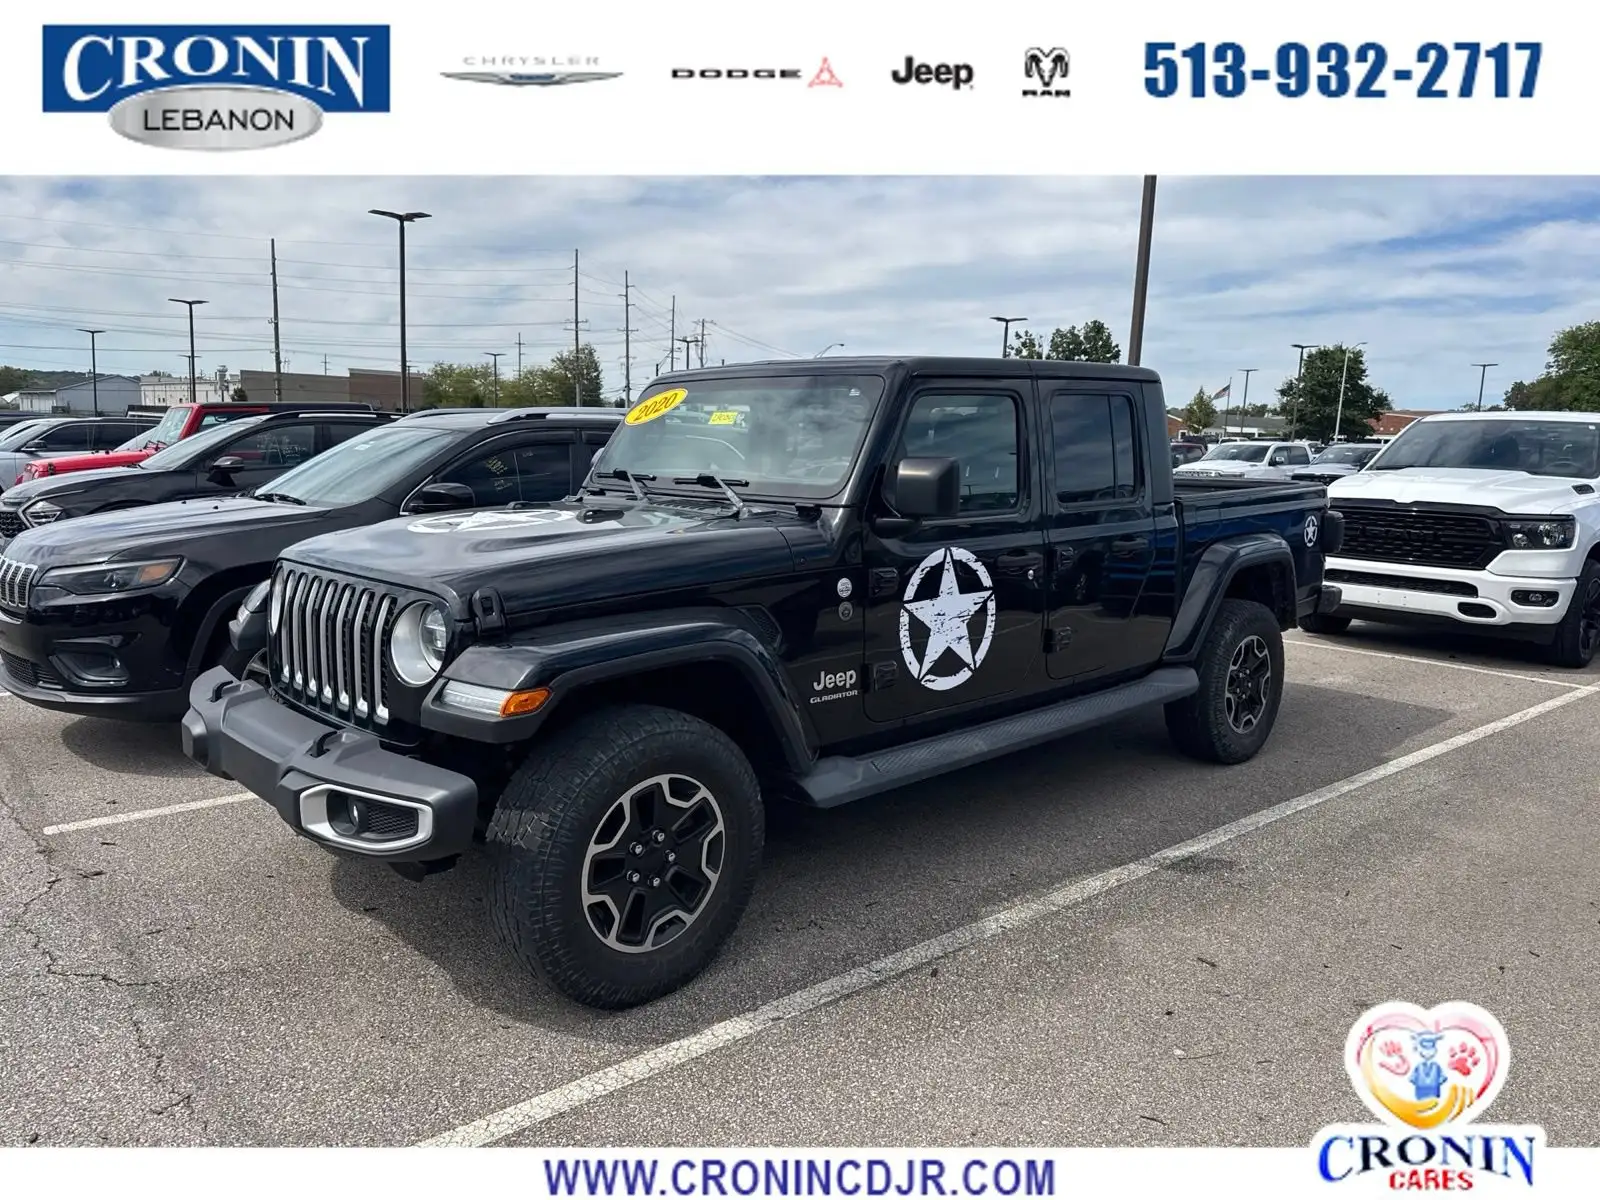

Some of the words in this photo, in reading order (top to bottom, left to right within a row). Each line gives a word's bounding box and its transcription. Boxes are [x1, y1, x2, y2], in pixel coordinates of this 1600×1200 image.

[632, 392, 678, 421] 2020
[813, 670, 857, 691] Jeep
[809, 689, 858, 704] GLADIATOR
